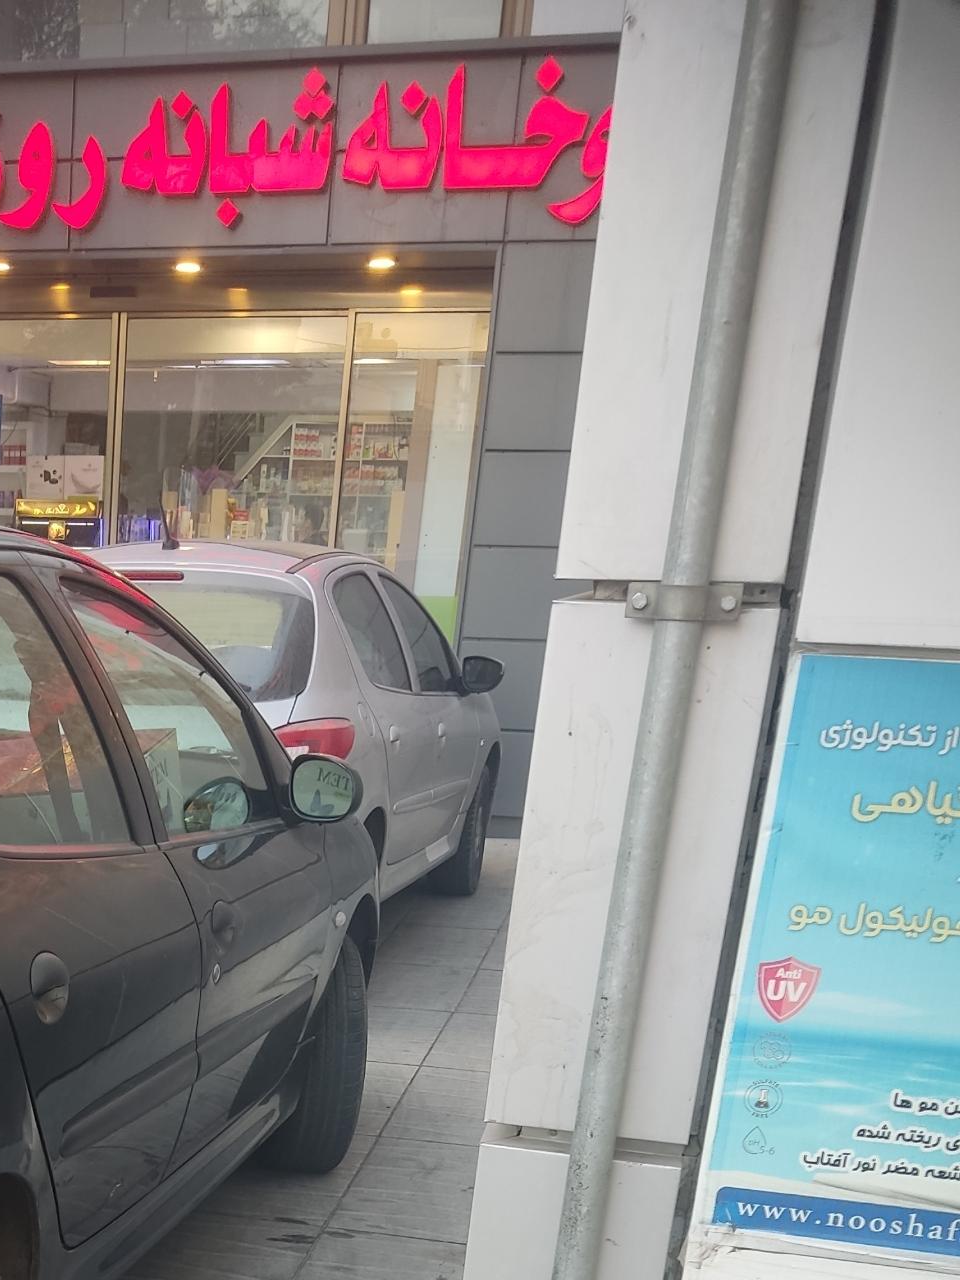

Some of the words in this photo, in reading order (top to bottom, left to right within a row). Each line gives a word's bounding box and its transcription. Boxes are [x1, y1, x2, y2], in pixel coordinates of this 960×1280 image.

[120, 66, 335, 229] شبانه
[342, 55, 614, 224] وخانه
[819, 719, 938, 751] تکنولوژی
[787, 904, 833, 931] مو
[839, 902, 960, 943] ولیکول
[776, 968, 802, 978] Anti
[766, 980, 807, 1002] UV
[893, 1092, 912, 1108] ها
[918, 1099, 938, 1112] مو
[856, 1123, 891, 1140] شده
[896, 1129, 941, 1148] ریخته
[803, 1151, 850, 1169] آفتاب
[852, 1157, 876, 1173] نور
[882, 1161, 919, 1176] مضر
[736, 1200, 960, 1242] www.nooshaf
